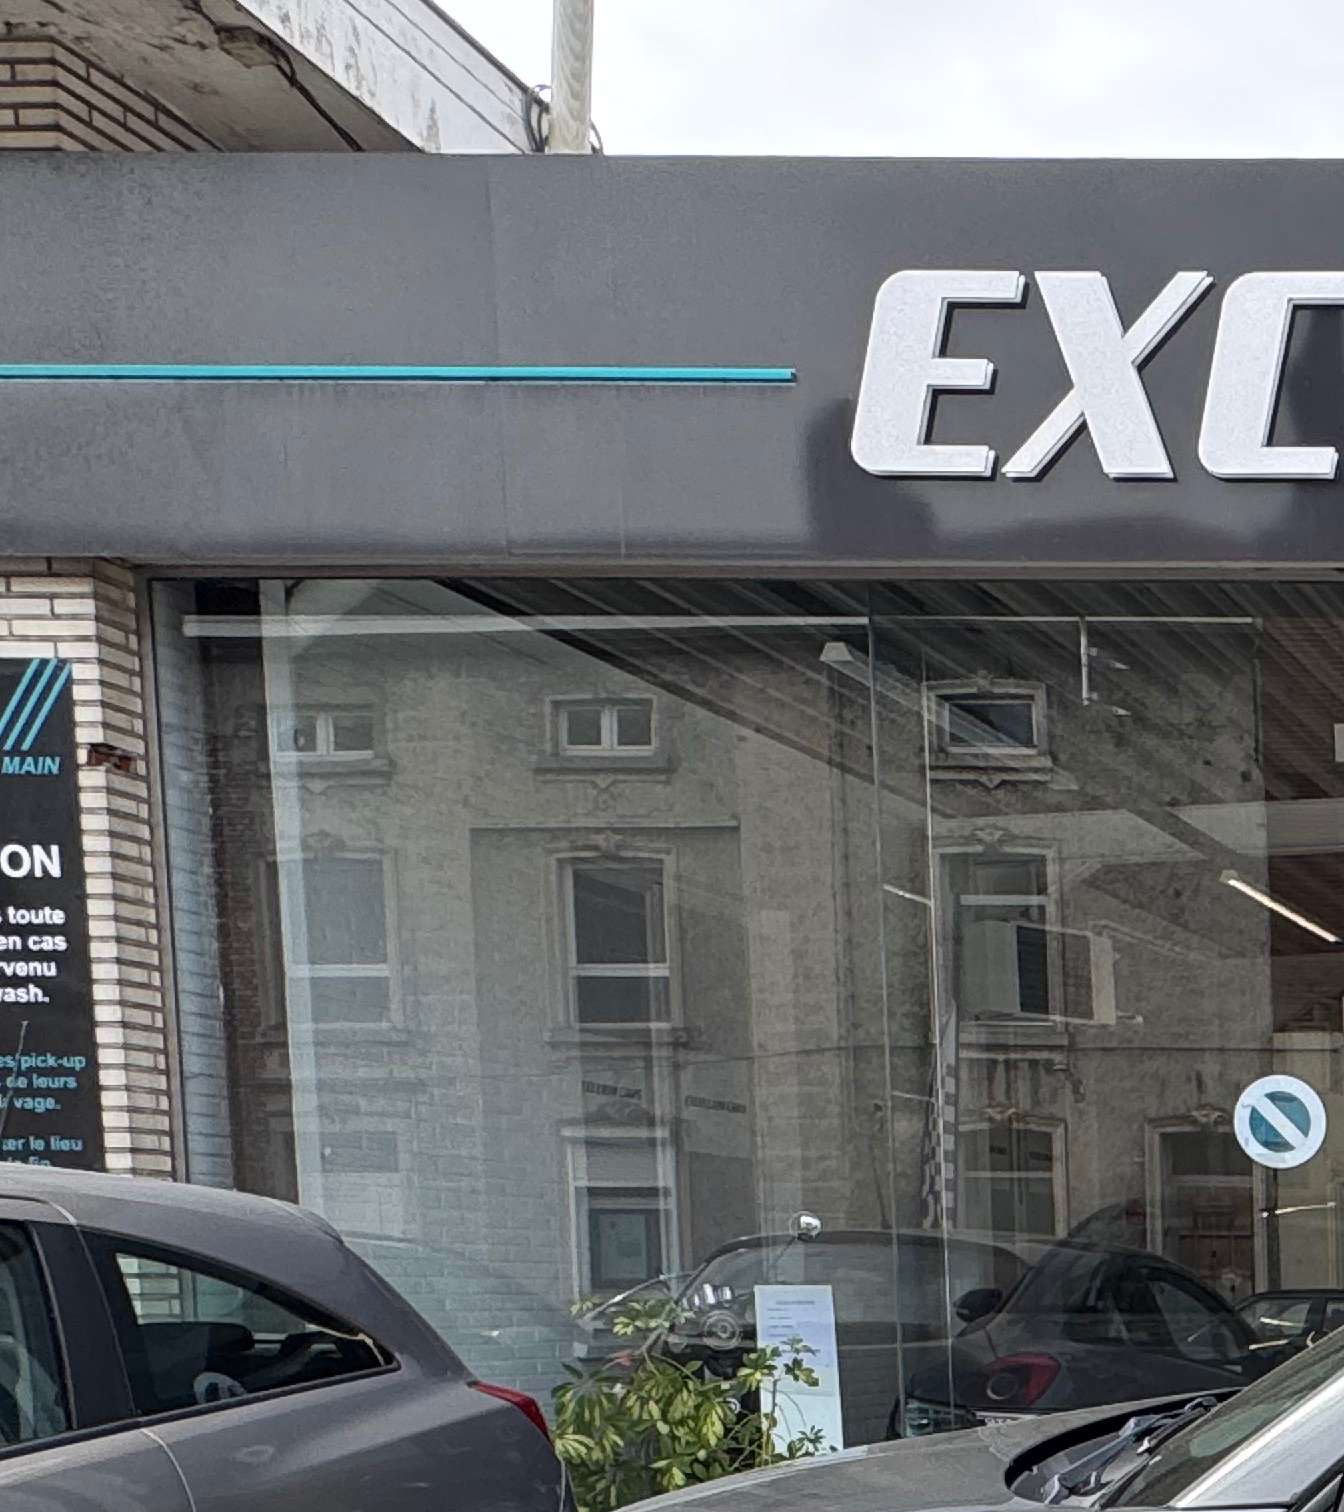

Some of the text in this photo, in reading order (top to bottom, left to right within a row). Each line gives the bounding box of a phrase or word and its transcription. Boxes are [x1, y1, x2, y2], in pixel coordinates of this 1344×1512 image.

[1, 756, 60, 775] MAIN
[8, 906, 66, 925] toute
[28, 935, 68, 952] cas
[0, 983, 50, 1004] ash.
[21, 1053, 86, 1072] pick-up
